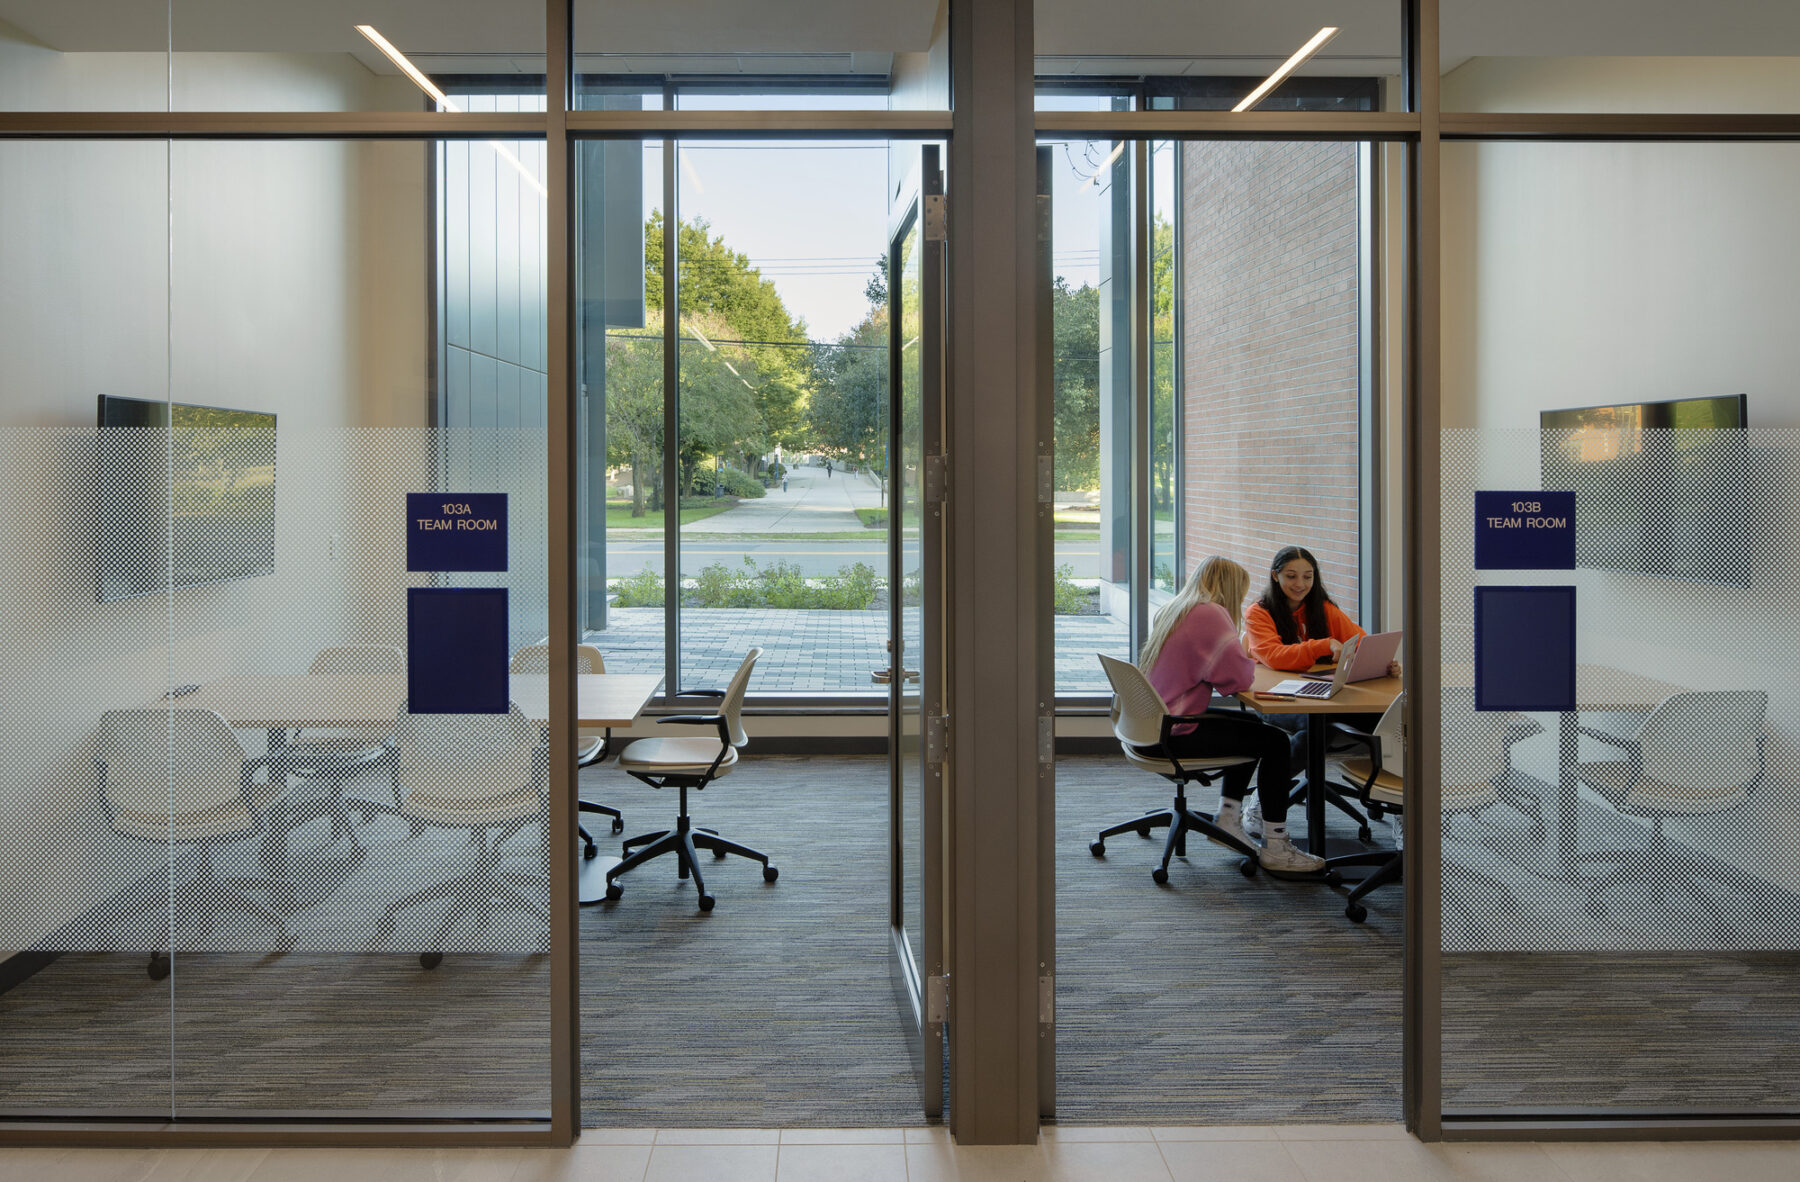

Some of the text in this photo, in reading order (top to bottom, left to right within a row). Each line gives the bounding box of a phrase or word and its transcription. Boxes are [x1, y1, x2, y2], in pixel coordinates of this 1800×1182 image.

[441, 503, 472, 514] 103A
[1511, 502, 1541, 513] 103B
[417, 519, 497, 530] TEAM ROOM
[1486, 517, 1566, 528] TEAM ROOM
